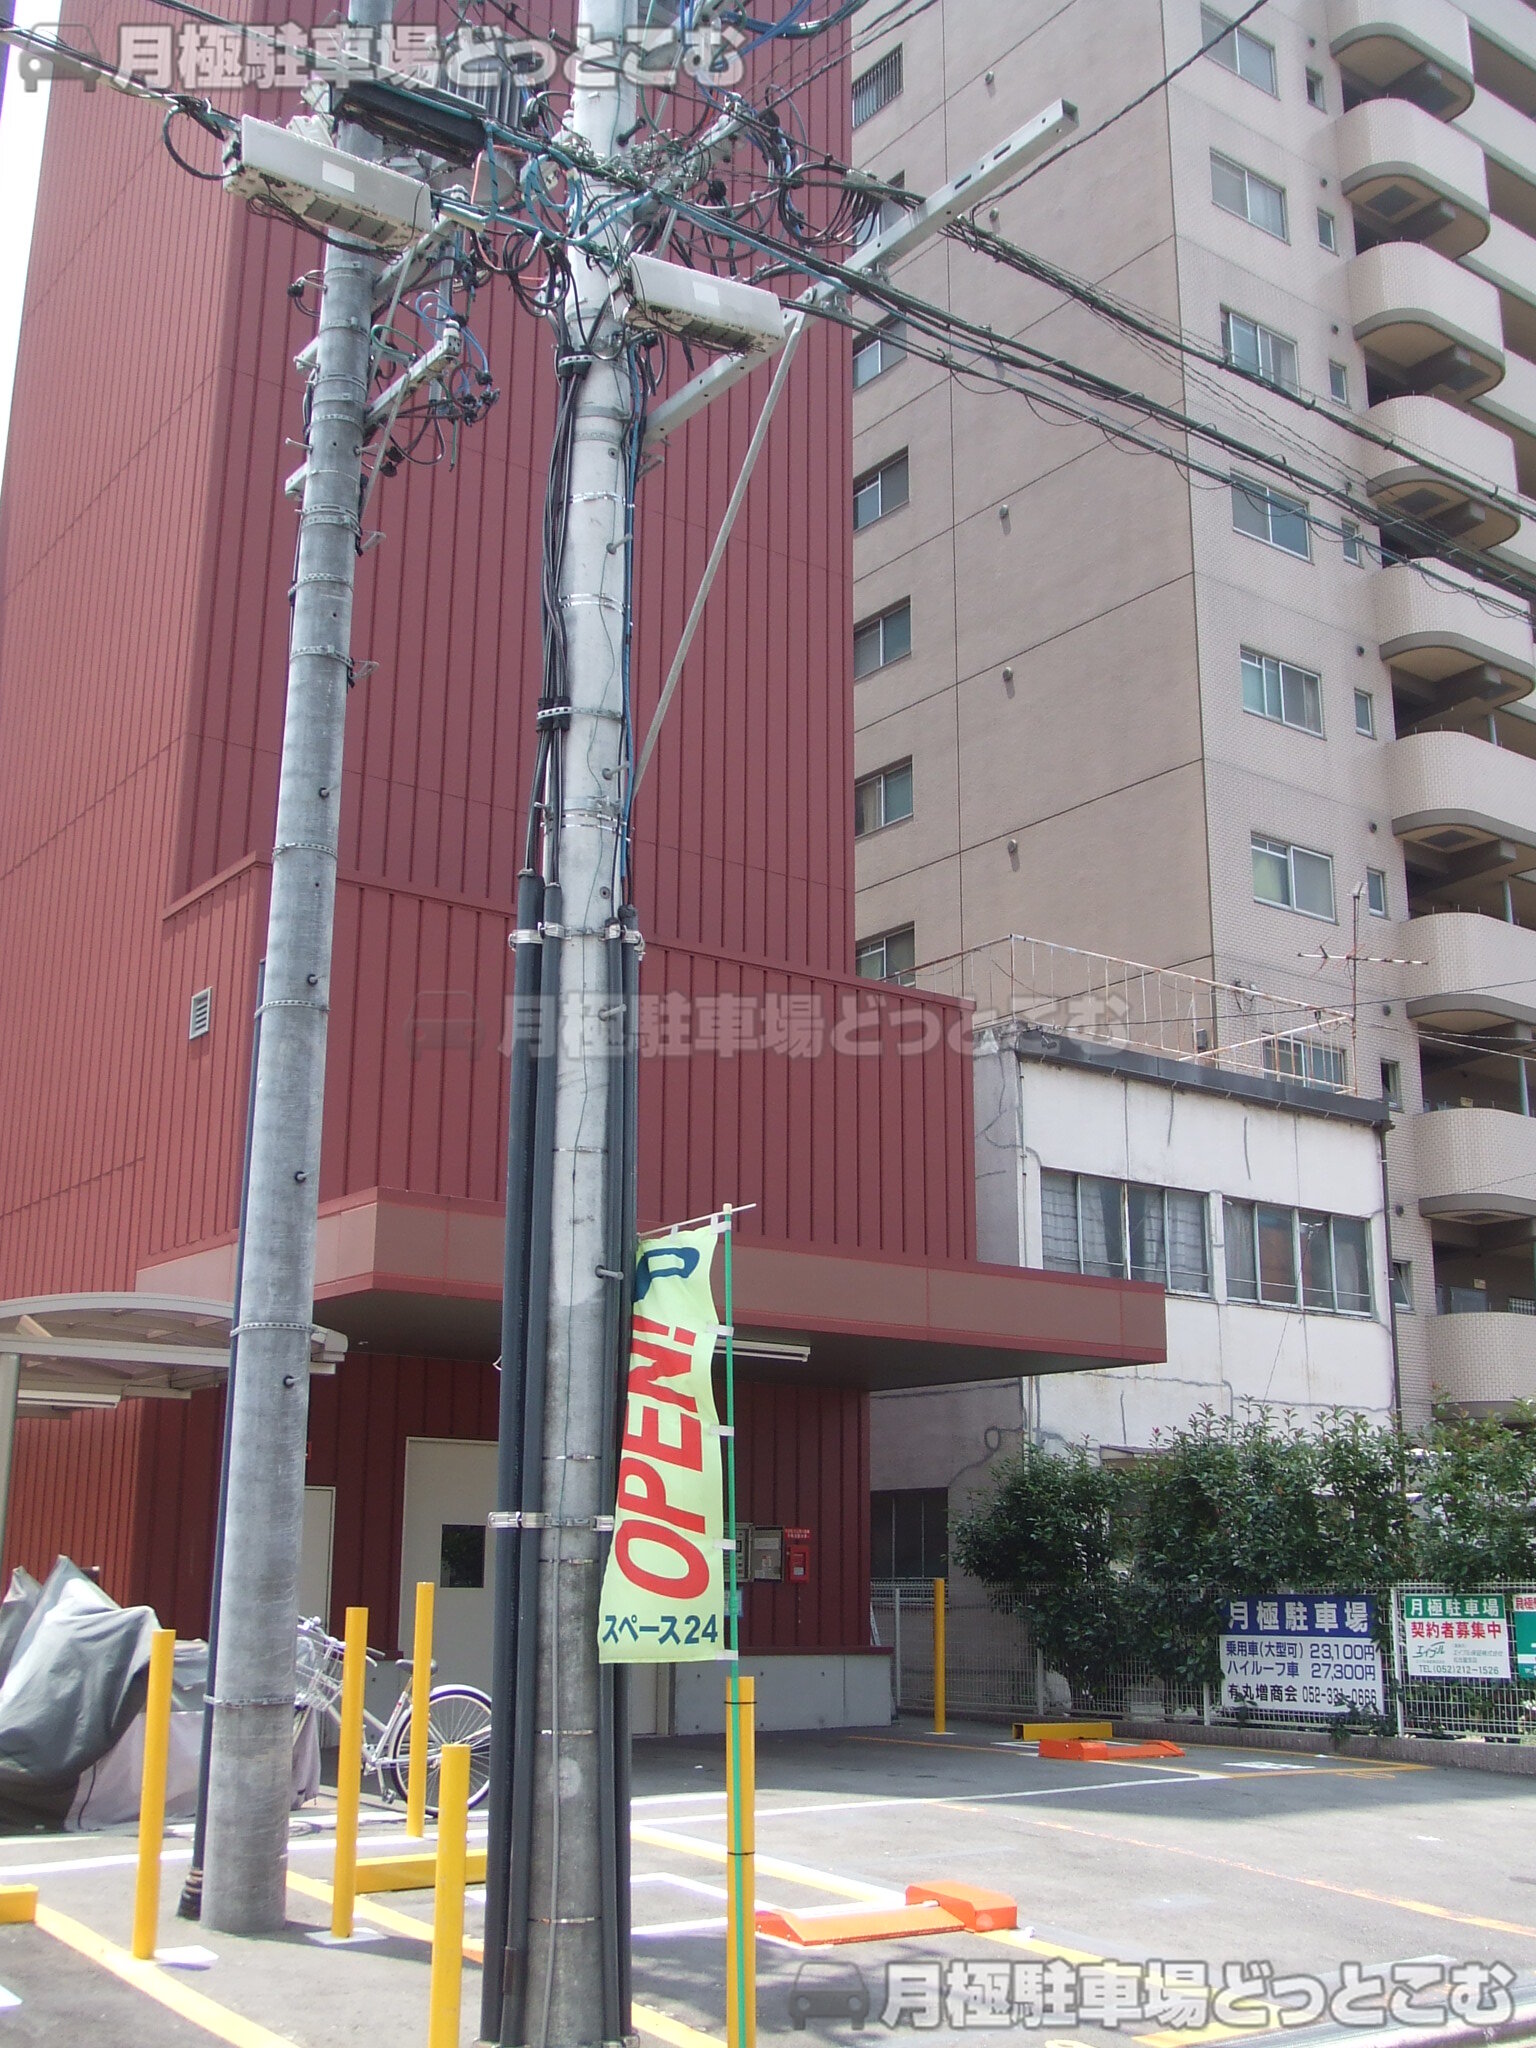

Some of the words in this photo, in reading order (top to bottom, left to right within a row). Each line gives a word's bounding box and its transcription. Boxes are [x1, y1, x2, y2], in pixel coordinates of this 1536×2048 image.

[614, 1314, 710, 1600] OPEN!
[1228, 1600, 1368, 1633] 月極駐車場
[1410, 1598, 1499, 1617] 月極駐車場
[602, 1614, 718, 1645] スペース24
[1410, 1620, 1502, 1639] 契約者募集中
[1225, 1640, 1304, 1659] 乗用車(大型可)
[1309, 1643, 1375, 1661] 23,100円
[1227, 1660, 1300, 1678] ハイルーフ車
[1311, 1662, 1376, 1681] 27,300円
